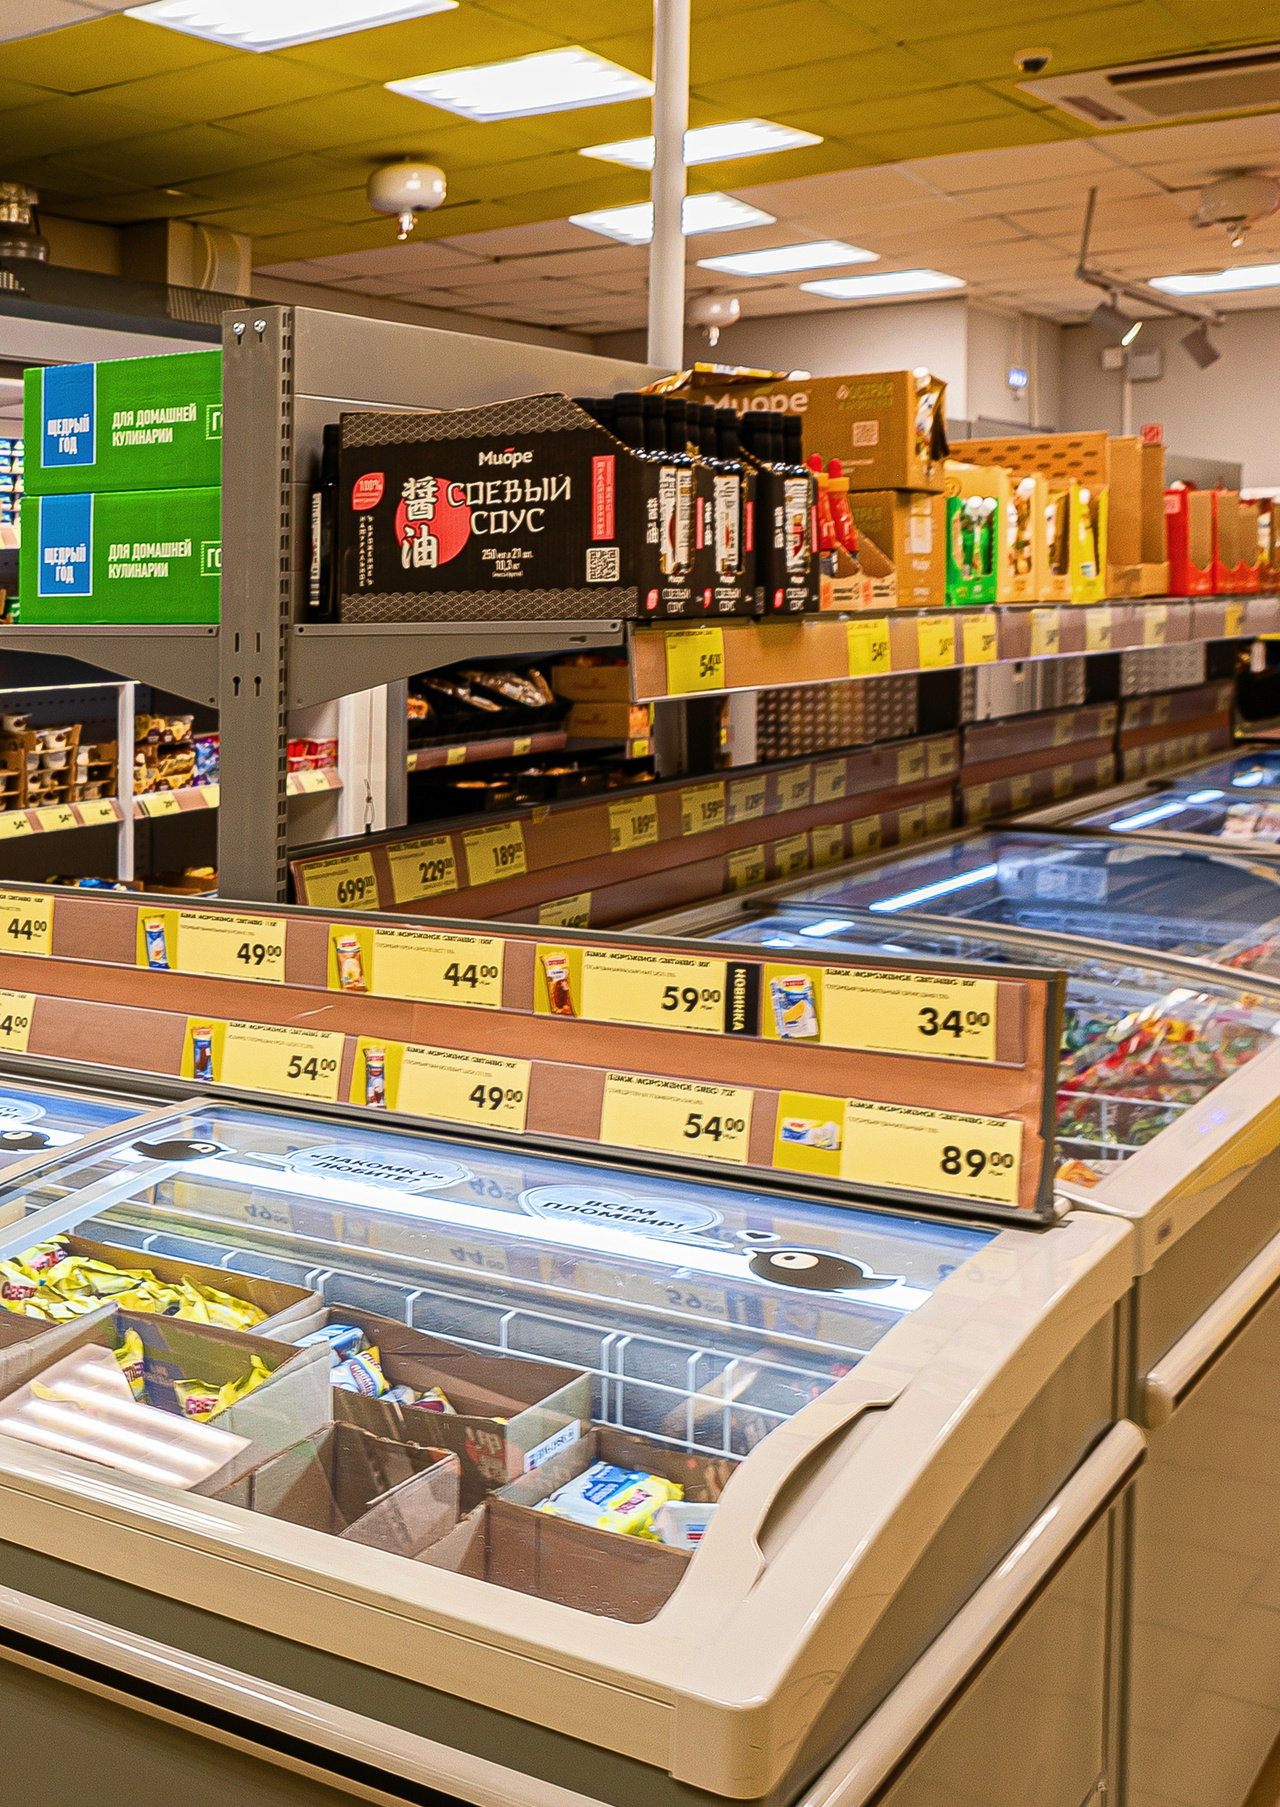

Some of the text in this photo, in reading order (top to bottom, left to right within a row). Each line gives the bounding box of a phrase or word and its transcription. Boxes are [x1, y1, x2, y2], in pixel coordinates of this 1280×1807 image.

[47, 414, 90, 437] ЩЕДРЫЙ
[112, 403, 197, 430] ДЛЯ ДОМАШНЕЙ
[58, 437, 78, 454] ГОД
[112, 428, 173, 447] КУЛИНАРИИ
[447, 473, 571, 507] СОЕВЫЙ
[471, 508, 545, 535] СОУС
[44, 544, 86, 565] ЩЕДРЫЙ
[108, 539, 192, 562] ДЛЯ ДОМАШНЕЙ
[55, 566, 74, 584] ГОД
[108, 563, 168, 579] КУЛИНАРИИ
[732, 968, 747, 1031] НОВИНКА
[584, 1199, 658, 1217] ВСЕМ
